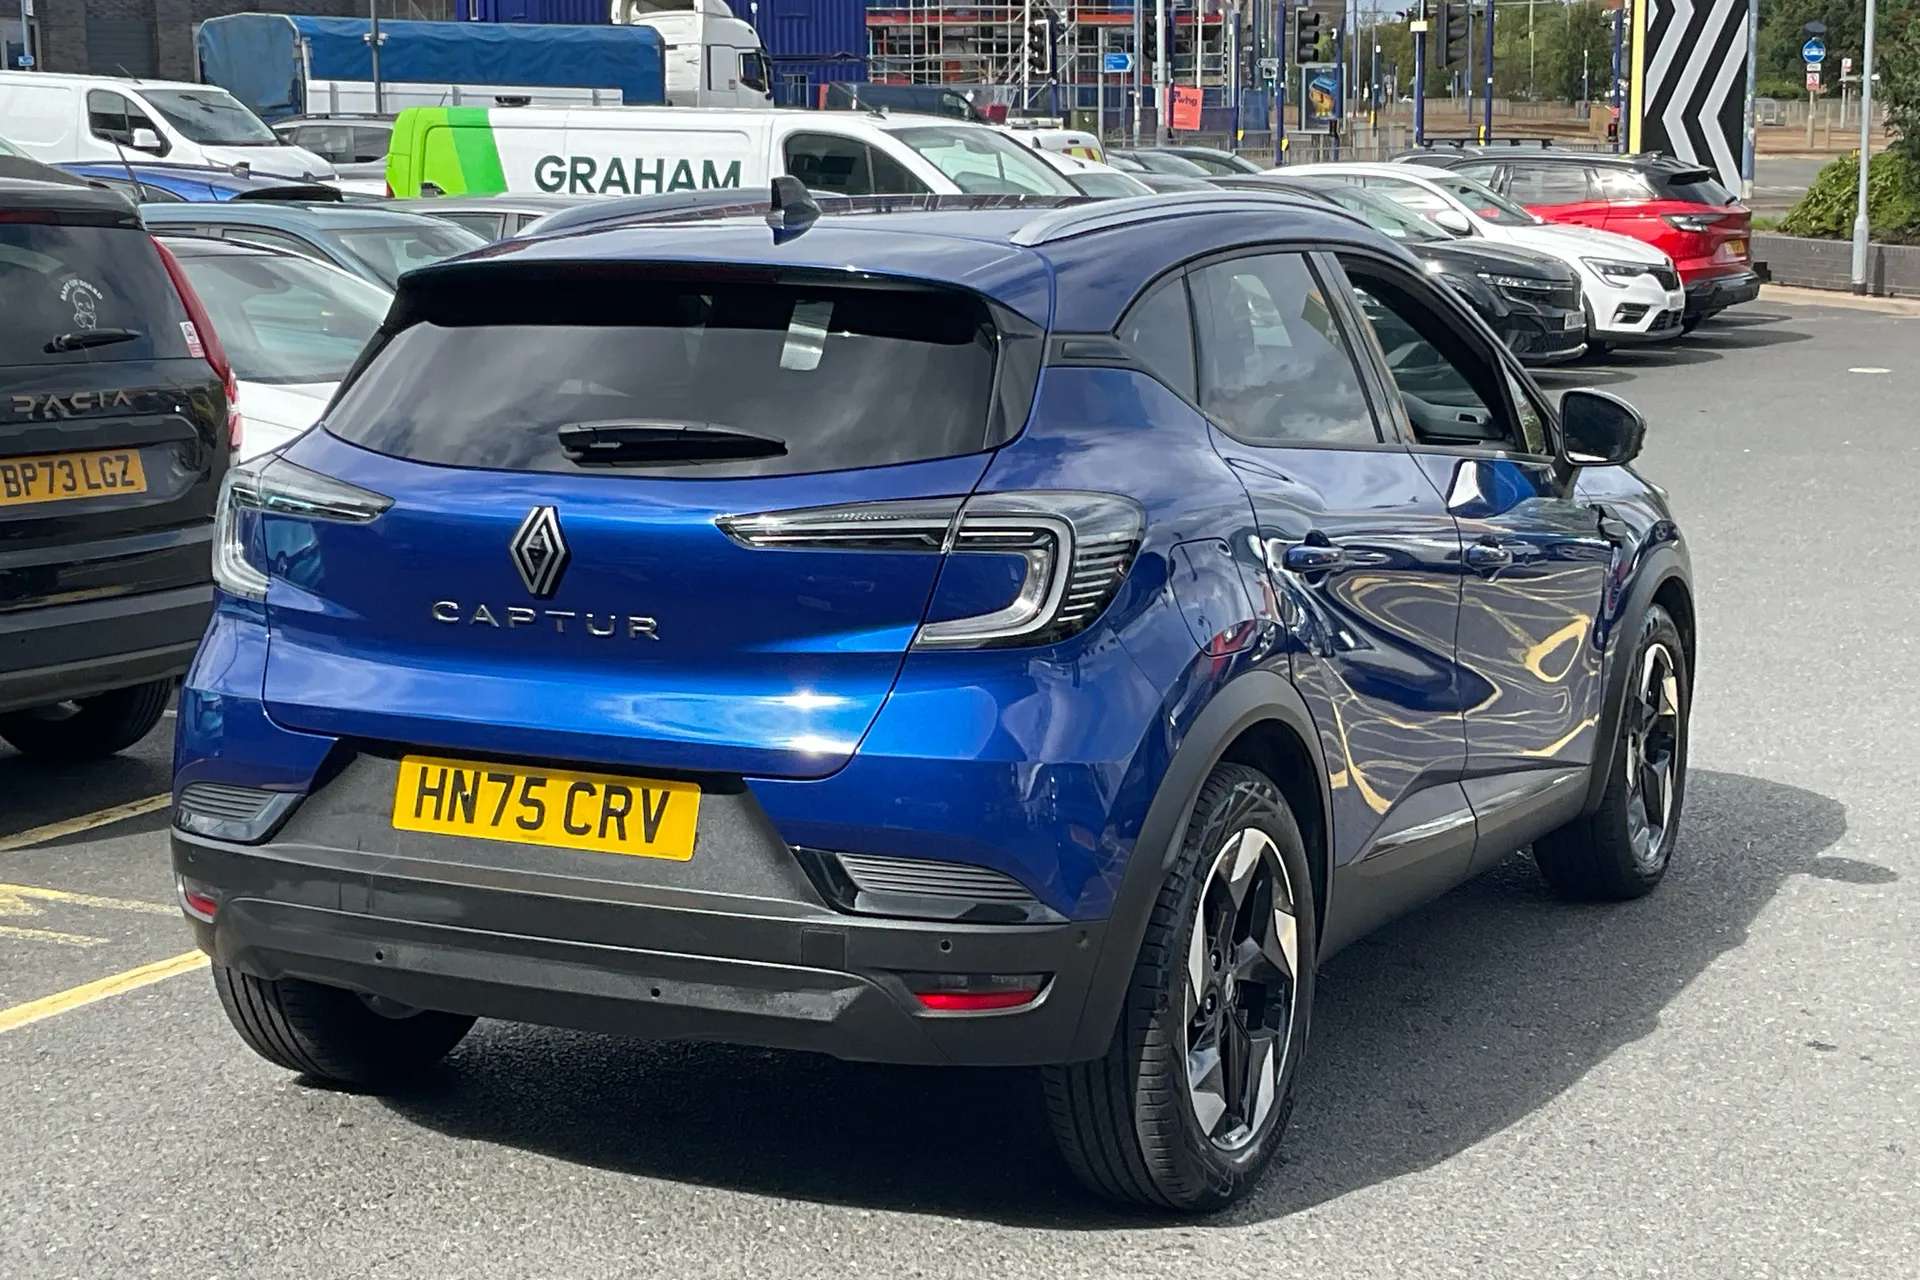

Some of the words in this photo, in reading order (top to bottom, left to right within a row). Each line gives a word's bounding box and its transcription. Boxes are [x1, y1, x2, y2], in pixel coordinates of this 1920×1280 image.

[1177, 96, 1198, 107] whg
[534, 155, 742, 195] GRAHAM
[12, 391, 132, 413] DACIA
[0, 460, 77, 498] BP73
[80, 454, 135, 490] LGZ
[432, 601, 660, 641] CAPTUR
[414, 765, 548, 831] HN75
[563, 780, 671, 844] CRV
